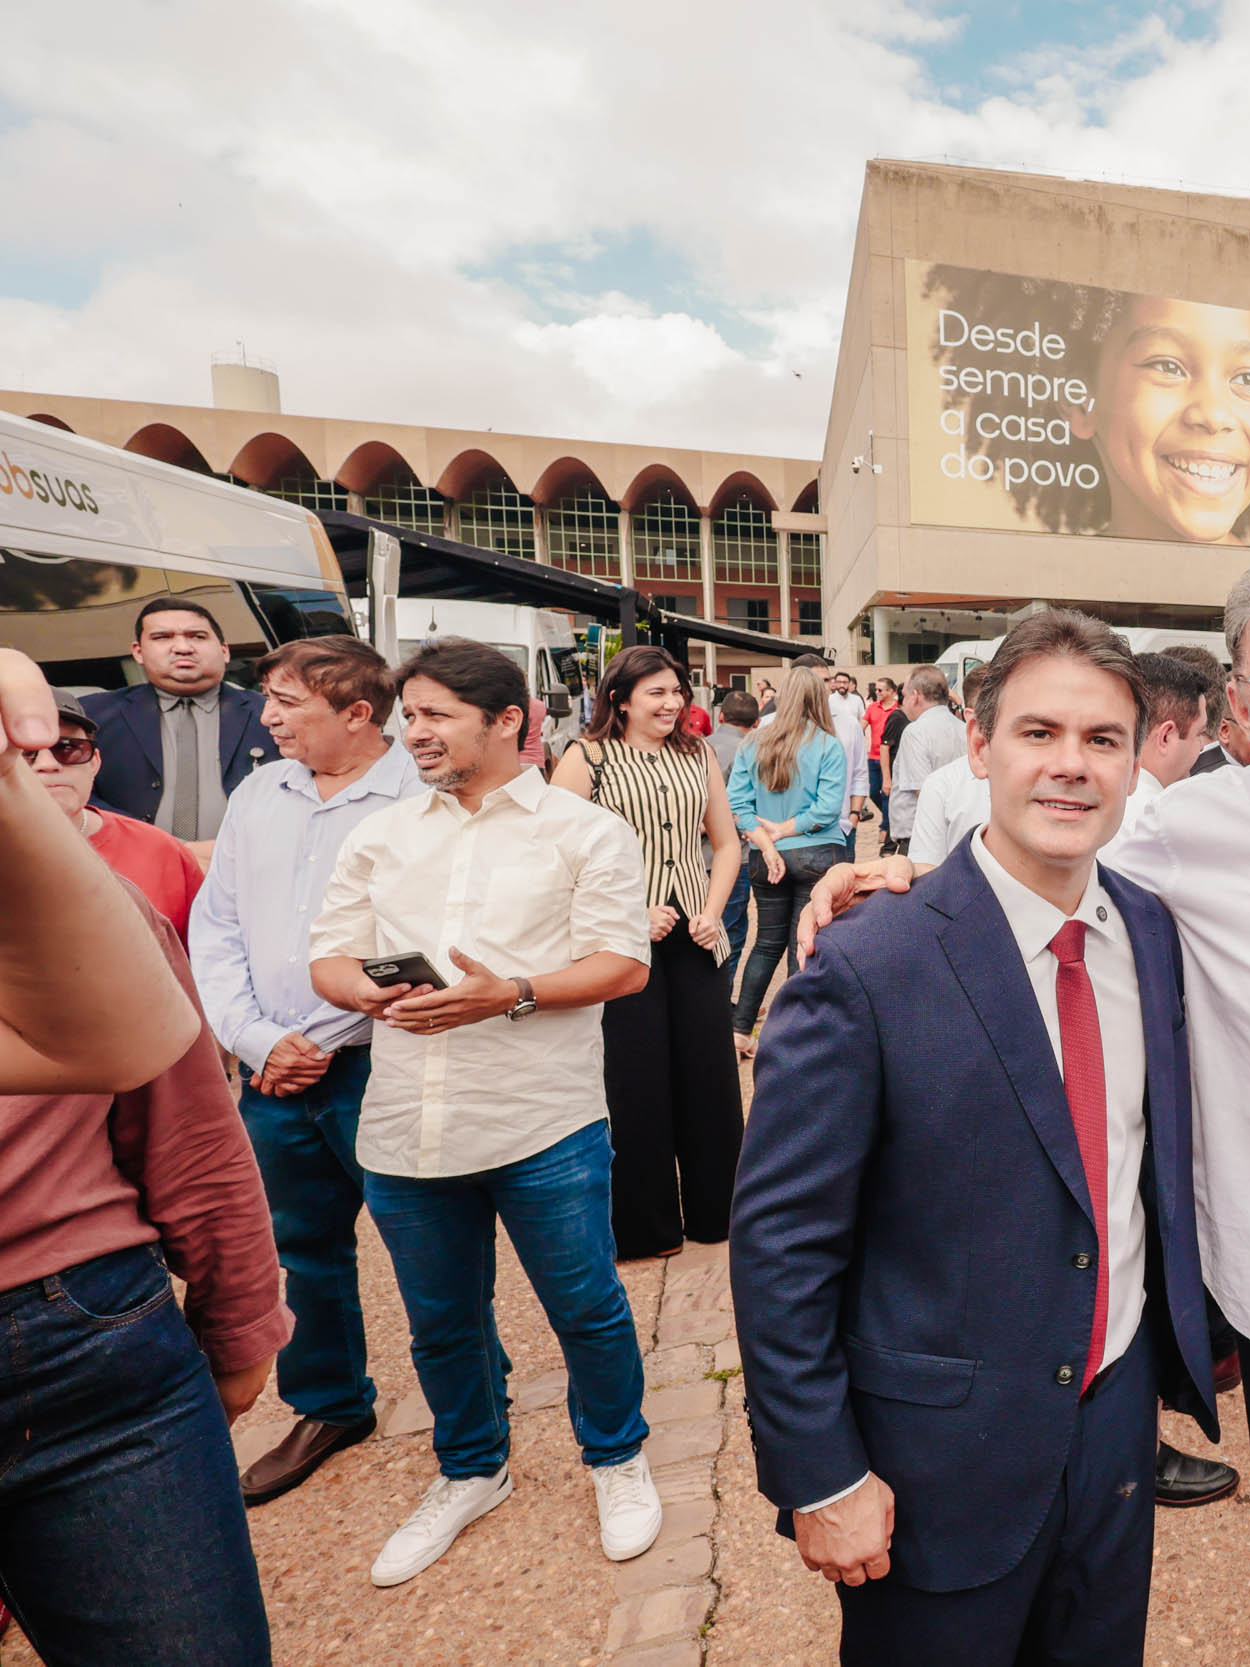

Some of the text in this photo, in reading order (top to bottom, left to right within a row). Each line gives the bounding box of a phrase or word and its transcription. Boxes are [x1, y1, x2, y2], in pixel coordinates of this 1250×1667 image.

[938, 309, 1066, 360] Desde
[938, 365, 1096, 413] sempre,
[940, 409, 1070, 446] a casa
[0, 450, 99, 515] obsuas
[940, 443, 1100, 491] do povo
